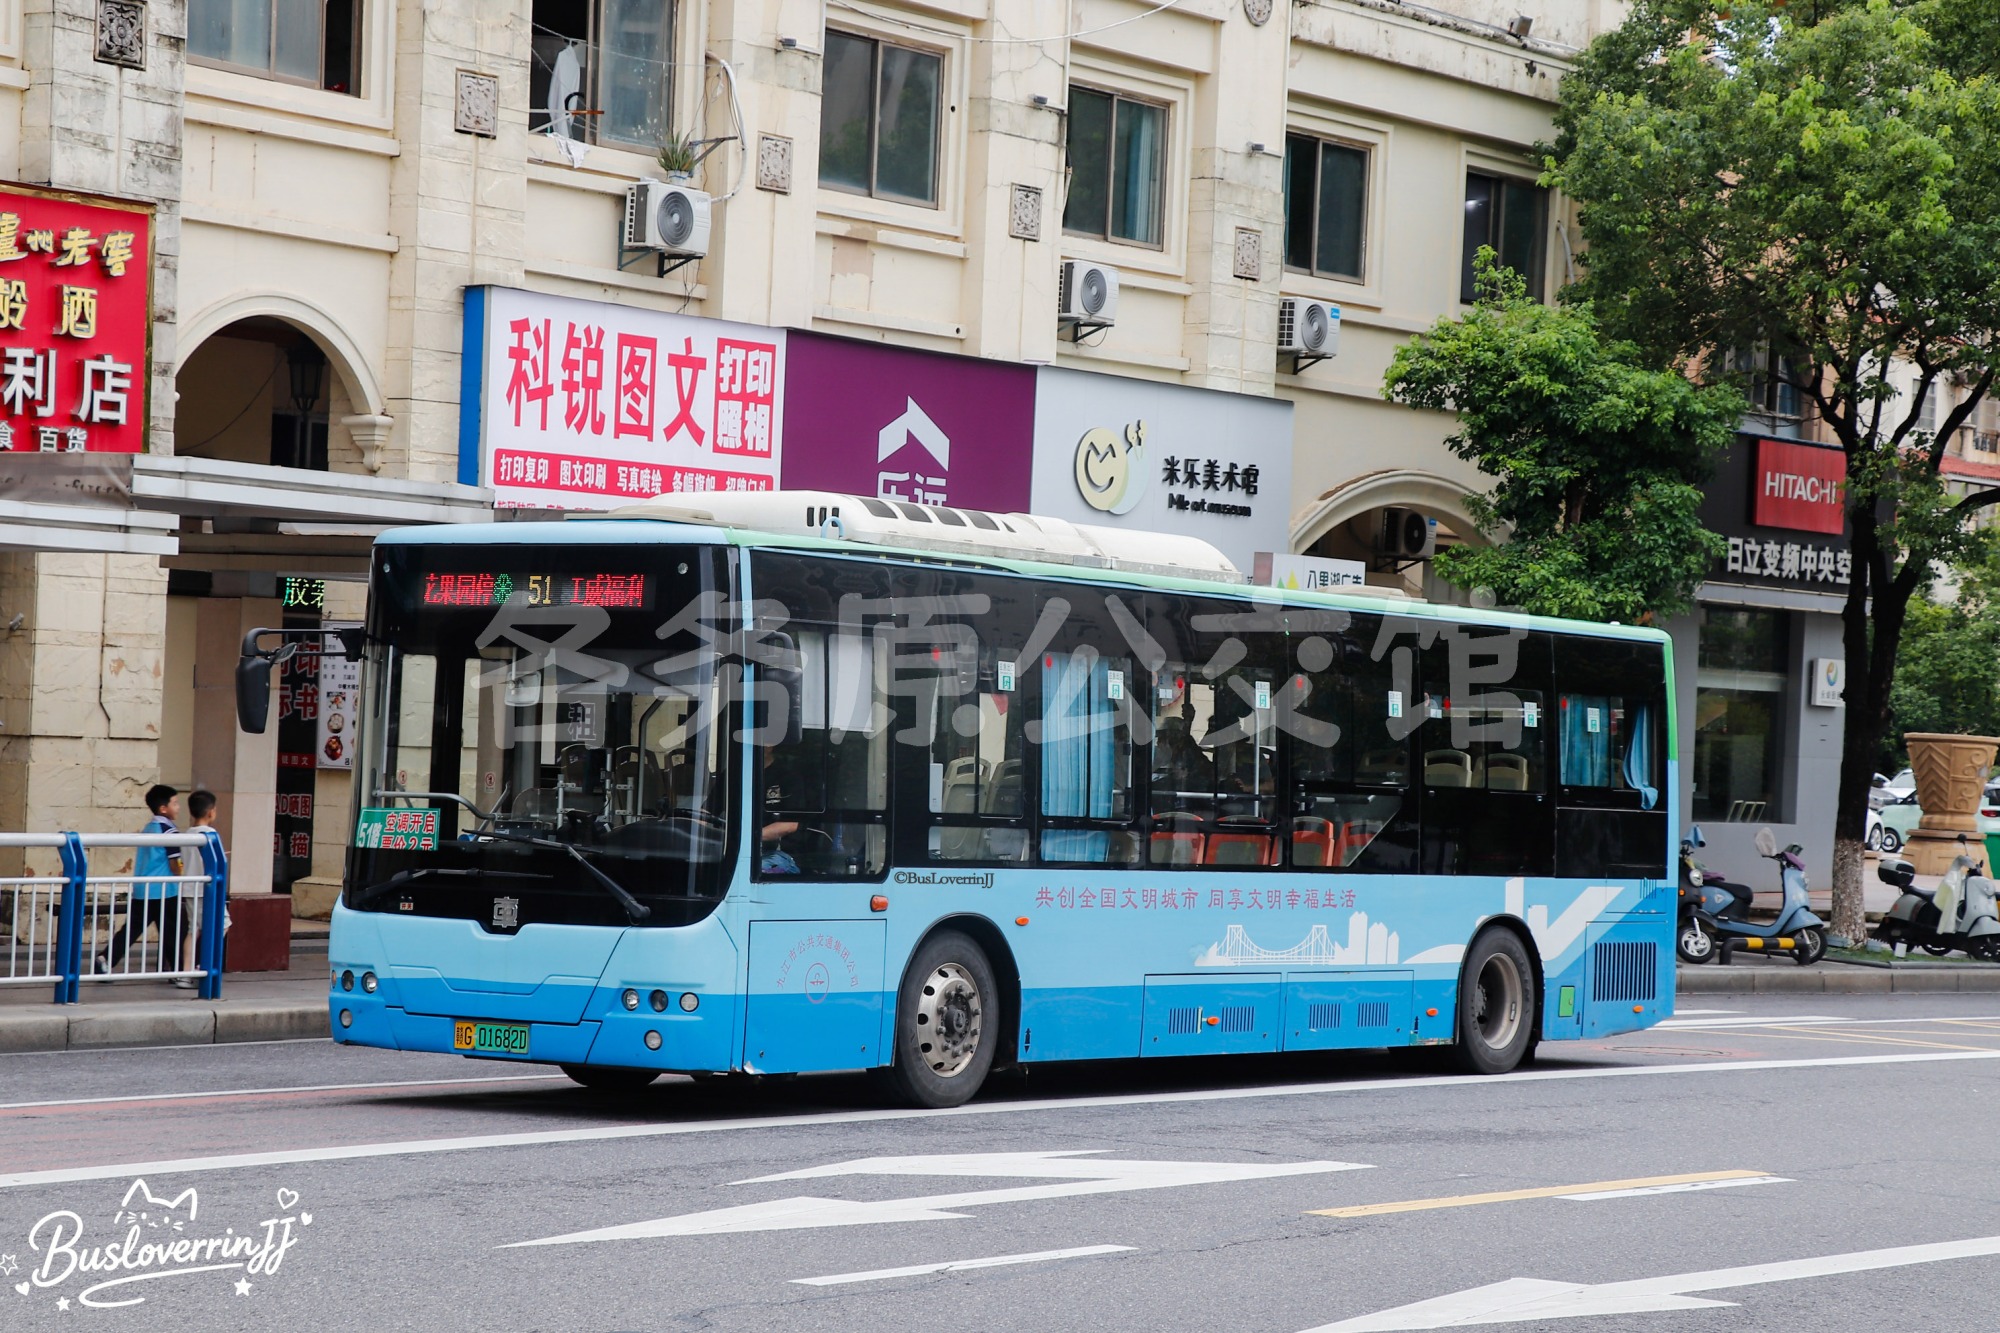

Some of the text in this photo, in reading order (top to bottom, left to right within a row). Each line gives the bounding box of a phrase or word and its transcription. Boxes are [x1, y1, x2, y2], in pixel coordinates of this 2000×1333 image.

[506, 317, 707, 448] 科锐图文
[718, 345, 772, 398] 打印
[38, 426, 88, 453] 百货
[716, 399, 773, 452] 照相
[500, 454, 549, 485] 打印复印
[559, 459, 607, 490] 图文印刷
[616, 465, 663, 495] 写真喷绘
[1161, 455, 1260, 495] 米乐美术馆
[1764, 470, 1837, 505] HITACHI
[527, 575, 551, 604] 51
[384, 811, 436, 834] 空调开启
[1035, 886, 1357, 911] 共创全国文明城市 同享文明幸福生活
